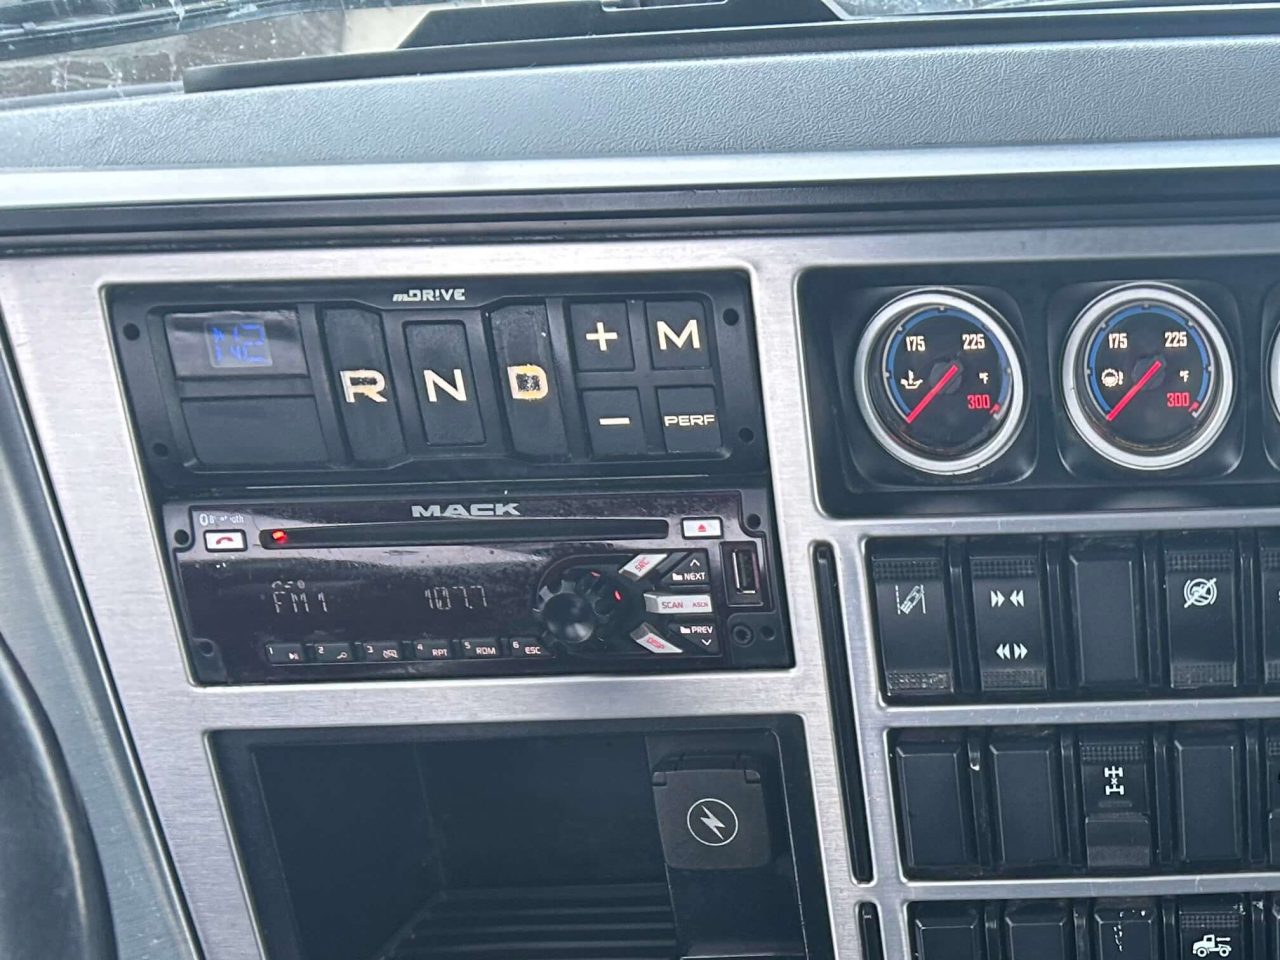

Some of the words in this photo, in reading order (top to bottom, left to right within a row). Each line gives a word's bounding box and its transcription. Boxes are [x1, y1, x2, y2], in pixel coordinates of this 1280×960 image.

[656, 319, 701, 350] M
[962, 333, 986, 350] 225
[1108, 333, 1128, 349] 175
[1164, 331, 1188, 347] 225
[905, 335, 926, 351] 175
[339, 368, 388, 403] R
[422, 368, 467, 403] N
[507, 363, 549, 401] D
[966, 394, 990, 409] 300
[1166, 392, 1190, 407] 300
[663, 414, 716, 427] PERF
[411, 503, 521, 518] MACK
[684, 572, 705, 580] NEXT
[692, 626, 713, 634] PREV
[318, 646, 324, 654] 2
[367, 645, 373, 653] 3
[525, 646, 541, 654] ESC
